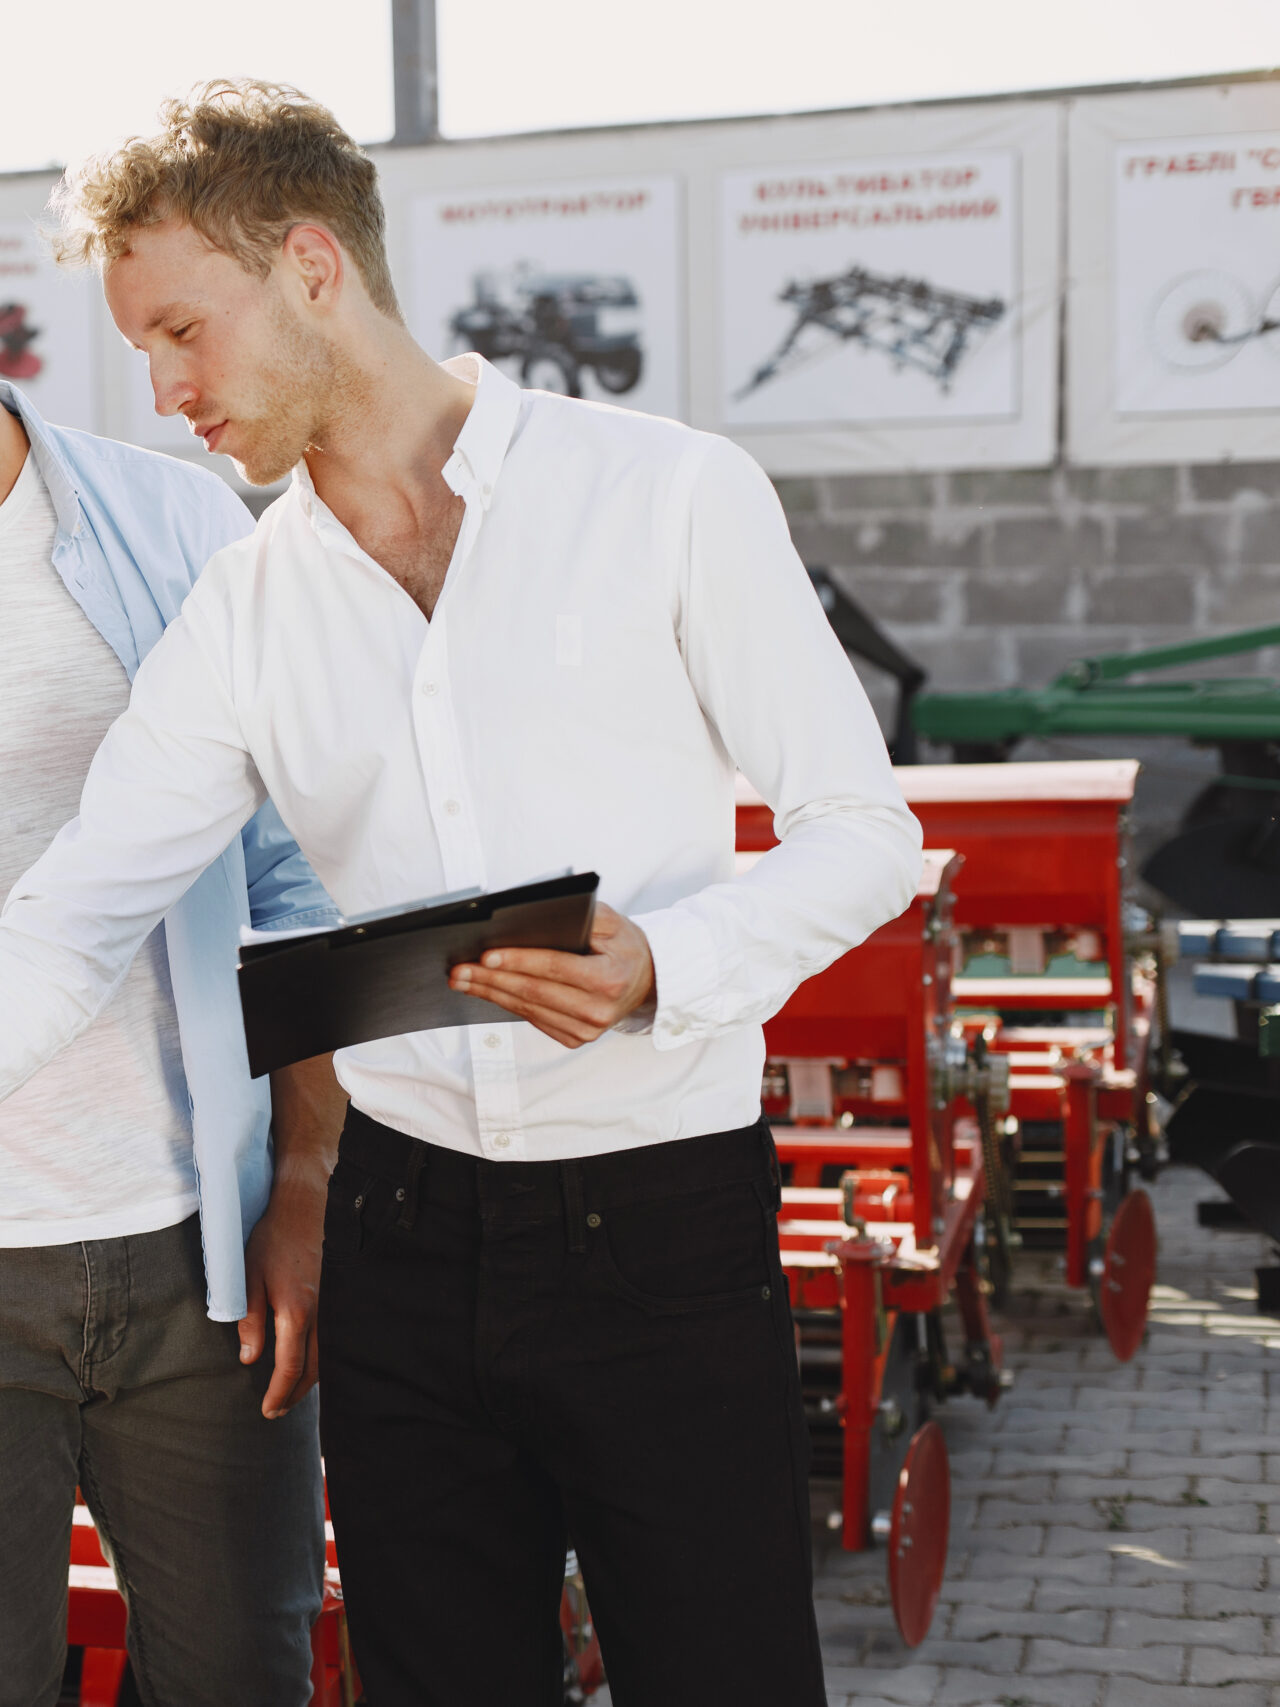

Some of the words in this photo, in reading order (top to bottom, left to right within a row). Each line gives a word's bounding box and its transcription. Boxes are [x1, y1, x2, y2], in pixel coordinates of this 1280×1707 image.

[1125, 150, 1236, 179] ГРАБЛІ
[755, 165, 979, 201] КУЛЬТИВАТОР
[441, 191, 649, 223] МОТОТРАКТОР
[738, 199, 999, 233] УНІВЕРСАЛЬНИЙ
